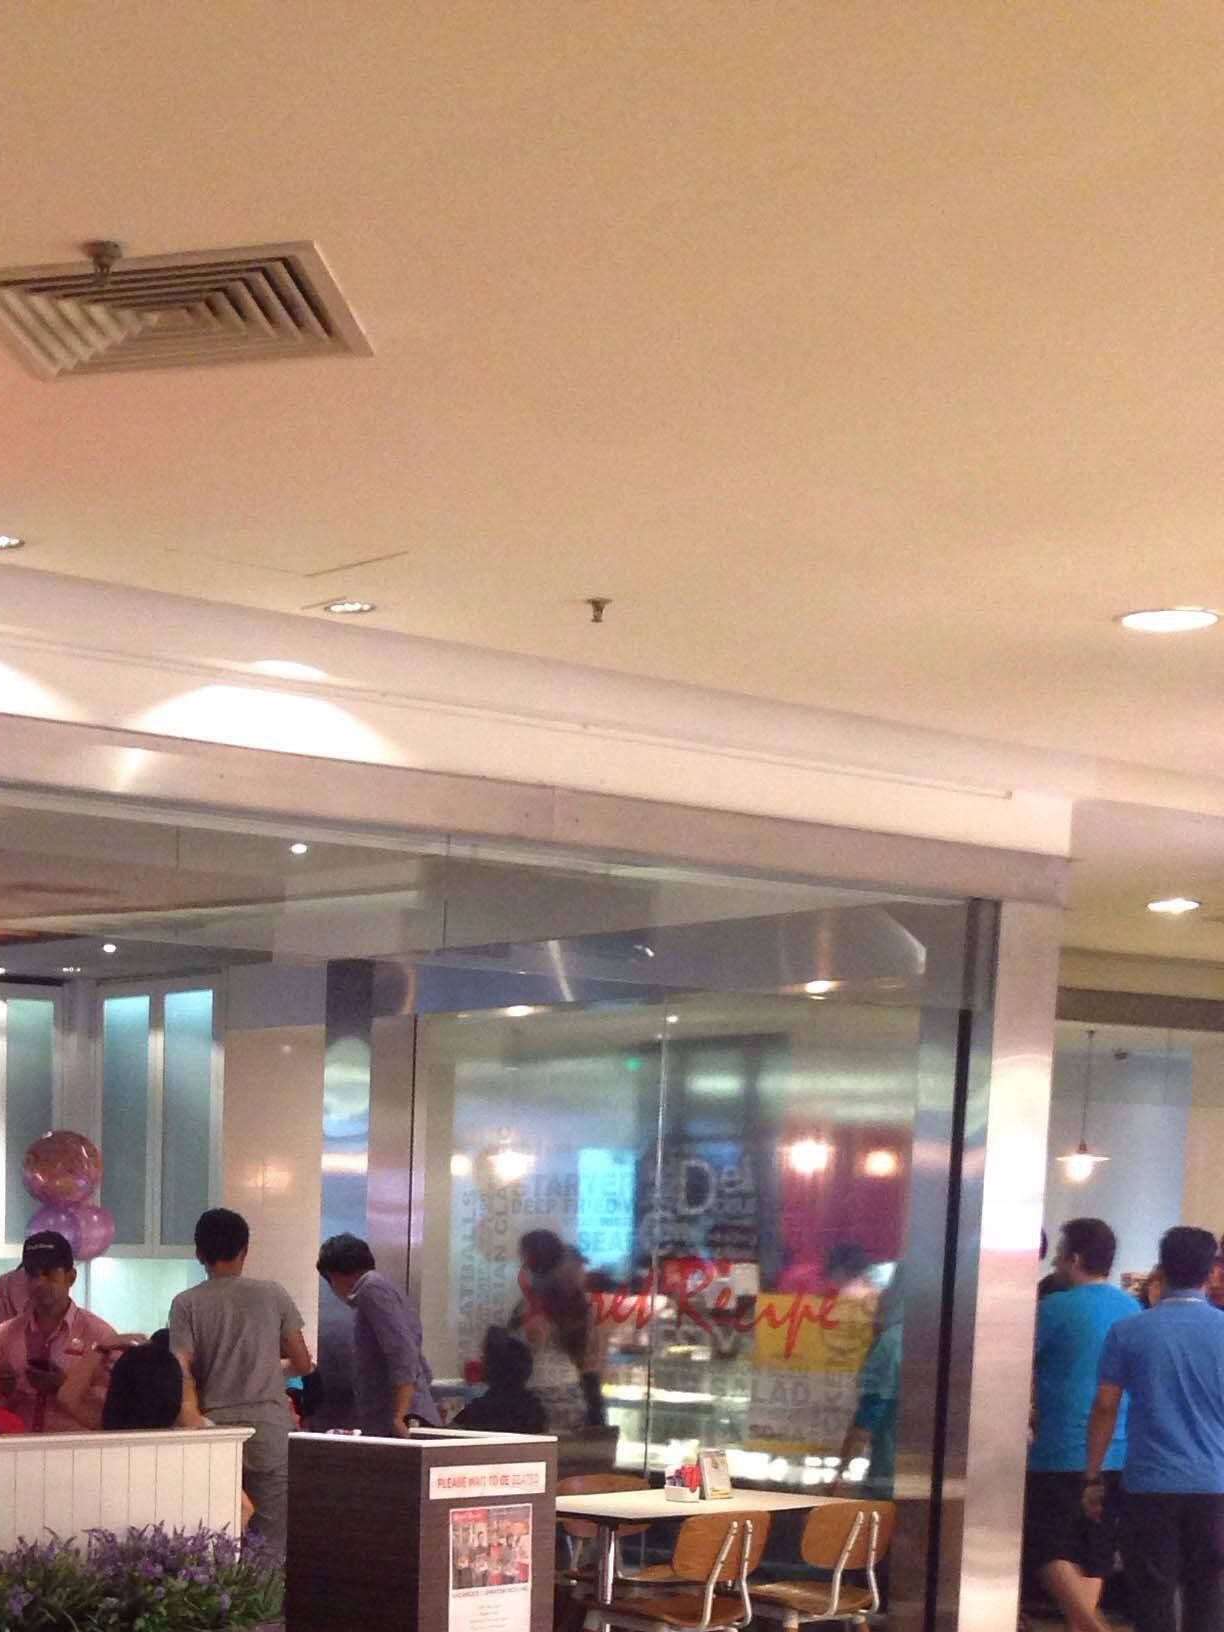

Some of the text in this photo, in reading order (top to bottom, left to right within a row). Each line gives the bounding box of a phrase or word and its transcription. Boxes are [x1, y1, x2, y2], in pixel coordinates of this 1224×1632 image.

[661, 1255, 840, 1360] Recipe
[437, 1475, 467, 1489] PLEASE
[489, 1473, 498, 1486] TO
